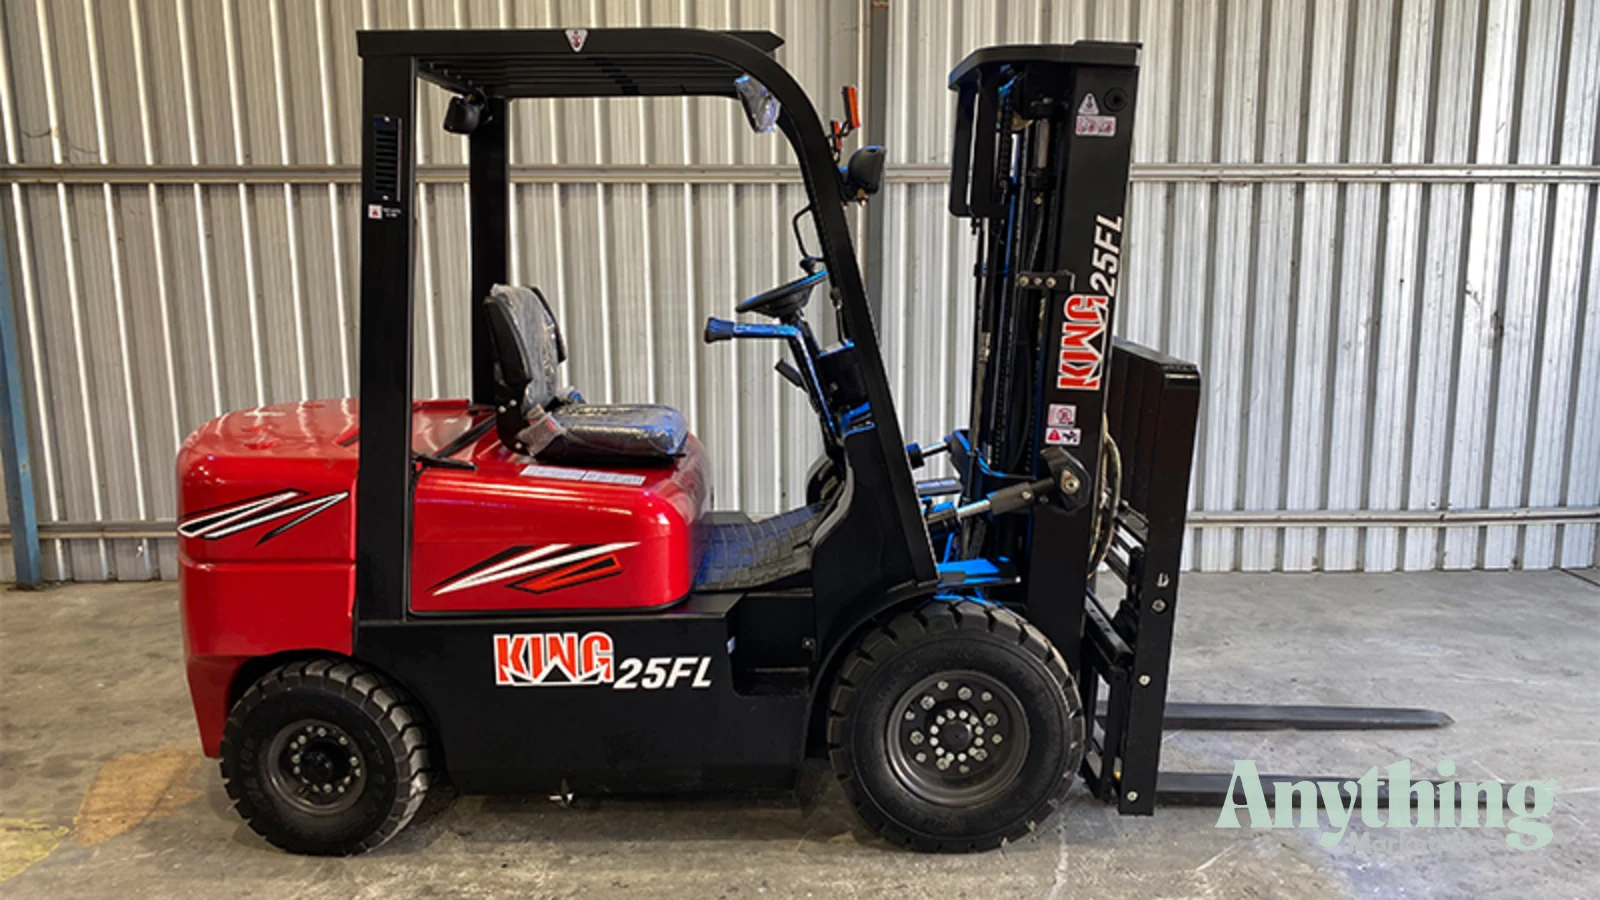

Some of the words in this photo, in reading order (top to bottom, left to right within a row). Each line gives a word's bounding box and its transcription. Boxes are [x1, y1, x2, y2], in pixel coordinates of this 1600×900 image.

[1057, 294, 1109, 390] KING
[1090, 215, 1123, 297] 25FL
[494, 631, 615, 686] KING
[614, 657, 712, 689] 25FL
